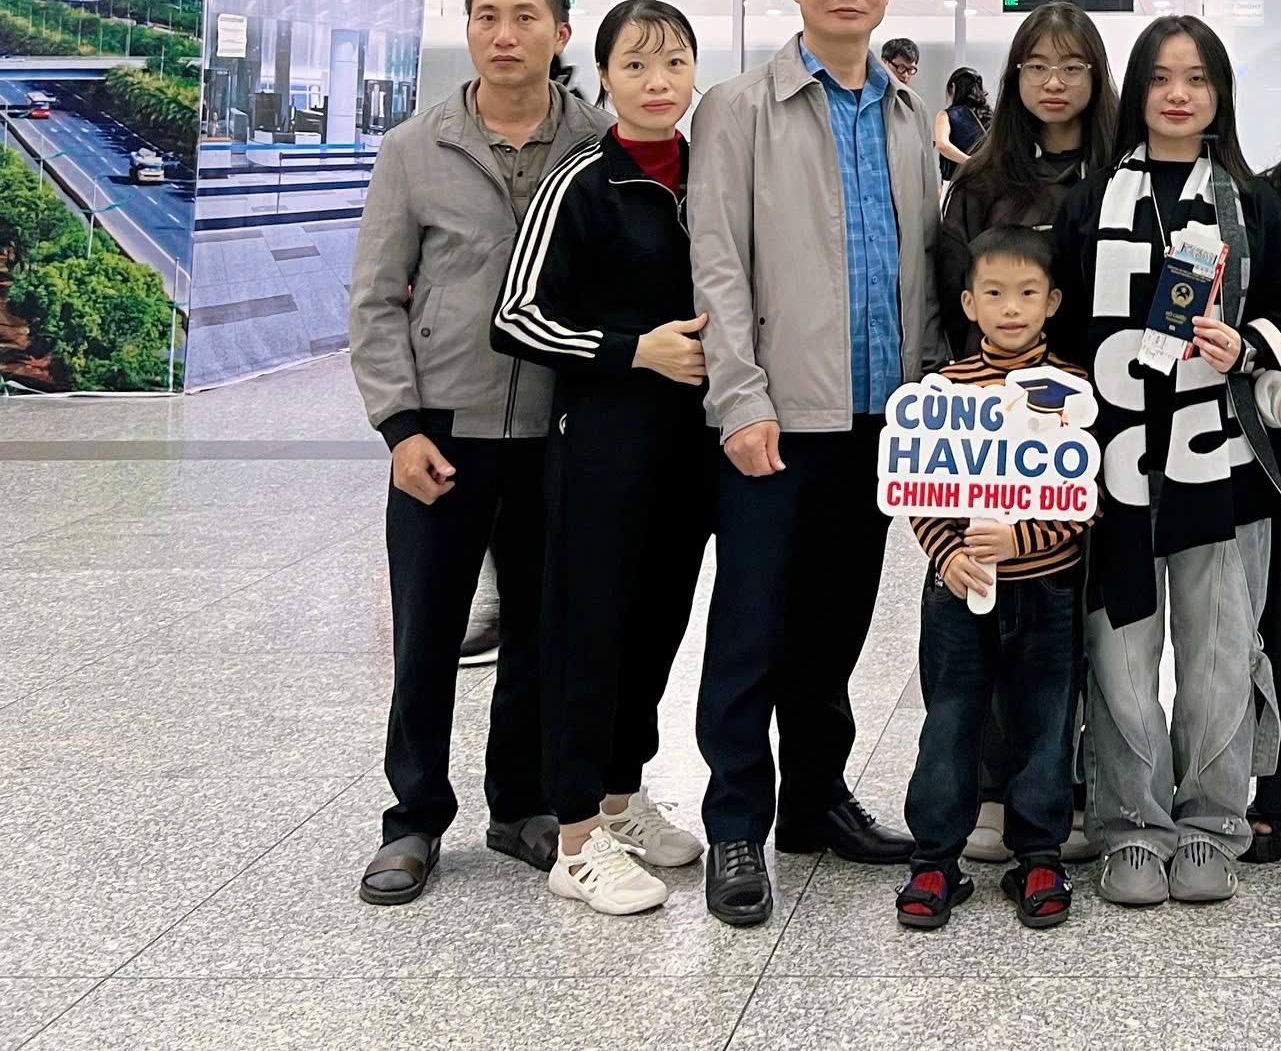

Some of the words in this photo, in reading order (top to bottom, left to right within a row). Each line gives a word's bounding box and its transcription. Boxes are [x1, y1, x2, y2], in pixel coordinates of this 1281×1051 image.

[895, 384, 1004, 432] CÙNG
[887, 436, 1089, 479] HAVICO
[886, 481, 960, 508] CHINH
[968, 483, 1032, 515] PHỤC
[1040, 480, 1088, 512] ĐỨC
